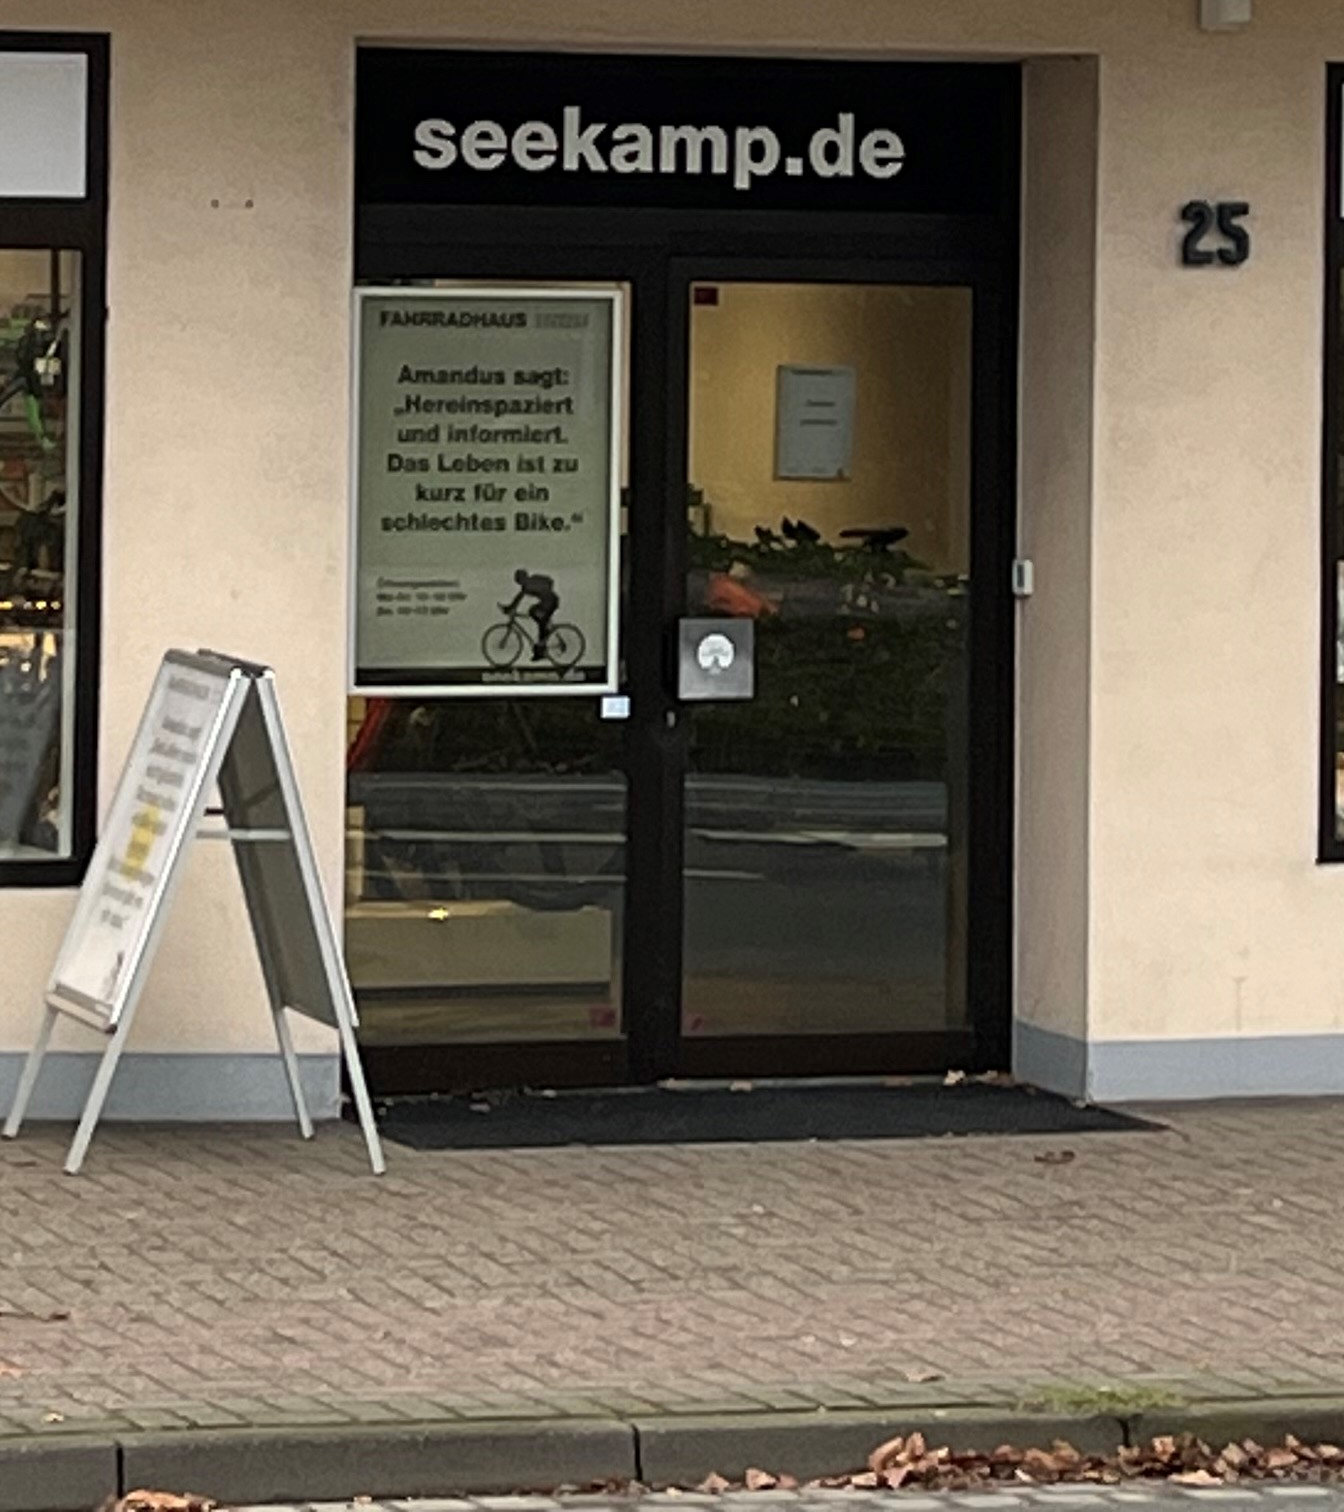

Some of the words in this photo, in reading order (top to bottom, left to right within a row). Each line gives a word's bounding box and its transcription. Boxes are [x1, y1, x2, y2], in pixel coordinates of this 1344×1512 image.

[413, 106, 905, 189] seekamp.de
[1181, 200, 1250, 266] 25
[380, 310, 528, 328] FAHRRADHAUS
[397, 365, 506, 385] Amandus
[513, 367, 570, 389] sagt:
[397, 425, 439, 443] und
[447, 424, 569, 444] informiert.
[387, 453, 430, 473] Das
[437, 454, 510, 473] Leben
[517, 455, 545, 474] ist
[553, 458, 579, 473] zu
[415, 483, 466, 502] kurz
[474, 483, 507, 502] für
[514, 483, 549, 502] ein
[380, 512, 506, 532] schlechtes
